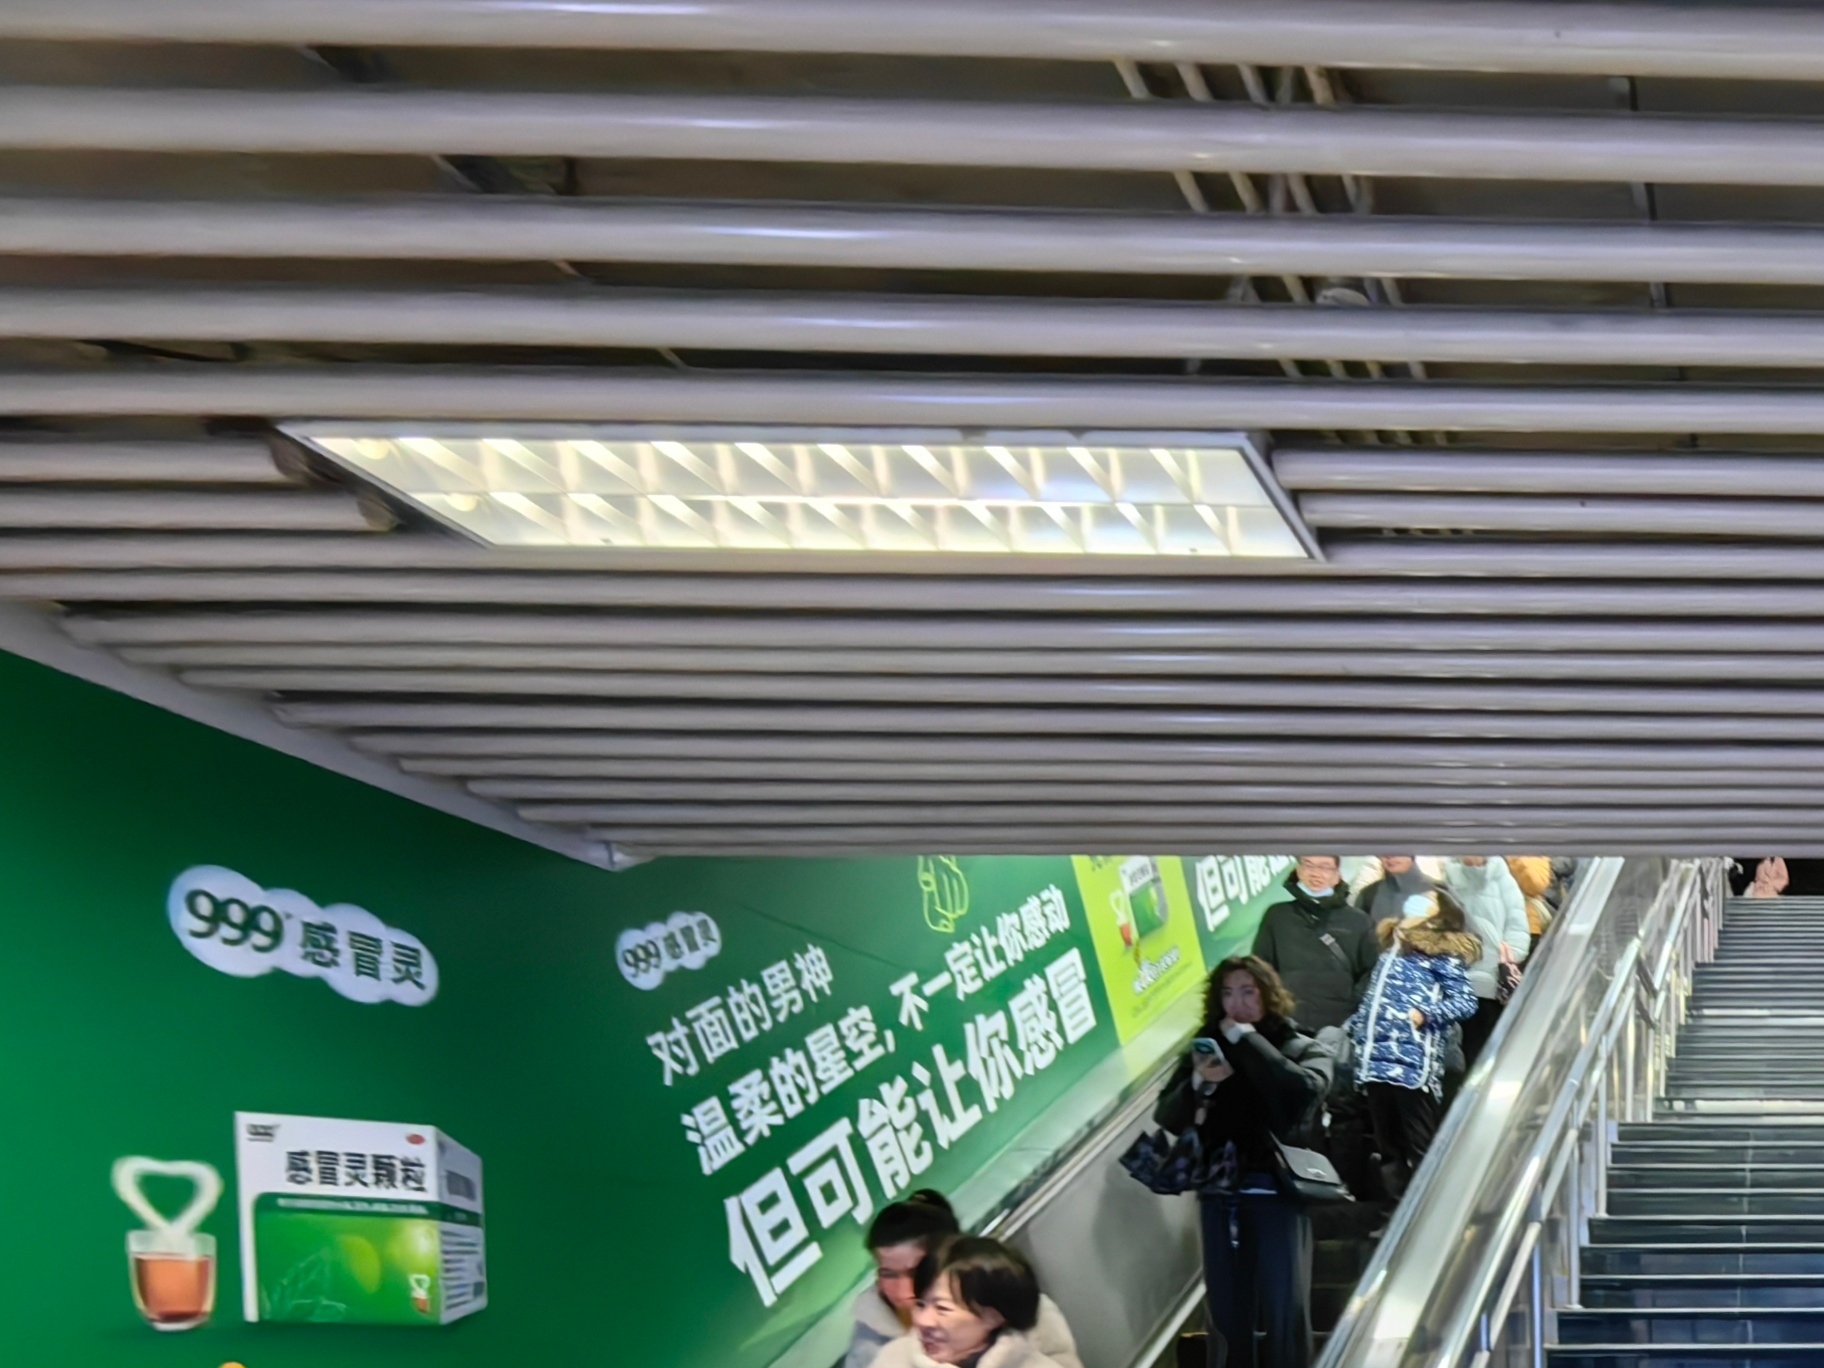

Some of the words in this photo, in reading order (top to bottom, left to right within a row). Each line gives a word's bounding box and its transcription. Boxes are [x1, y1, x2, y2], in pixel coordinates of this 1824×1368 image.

[645, 942, 834, 1087] 对面的男神
[284, 1149, 429, 1193] 感冒灵颗粒
[723, 946, 1098, 1307] 但可能让你感冒
